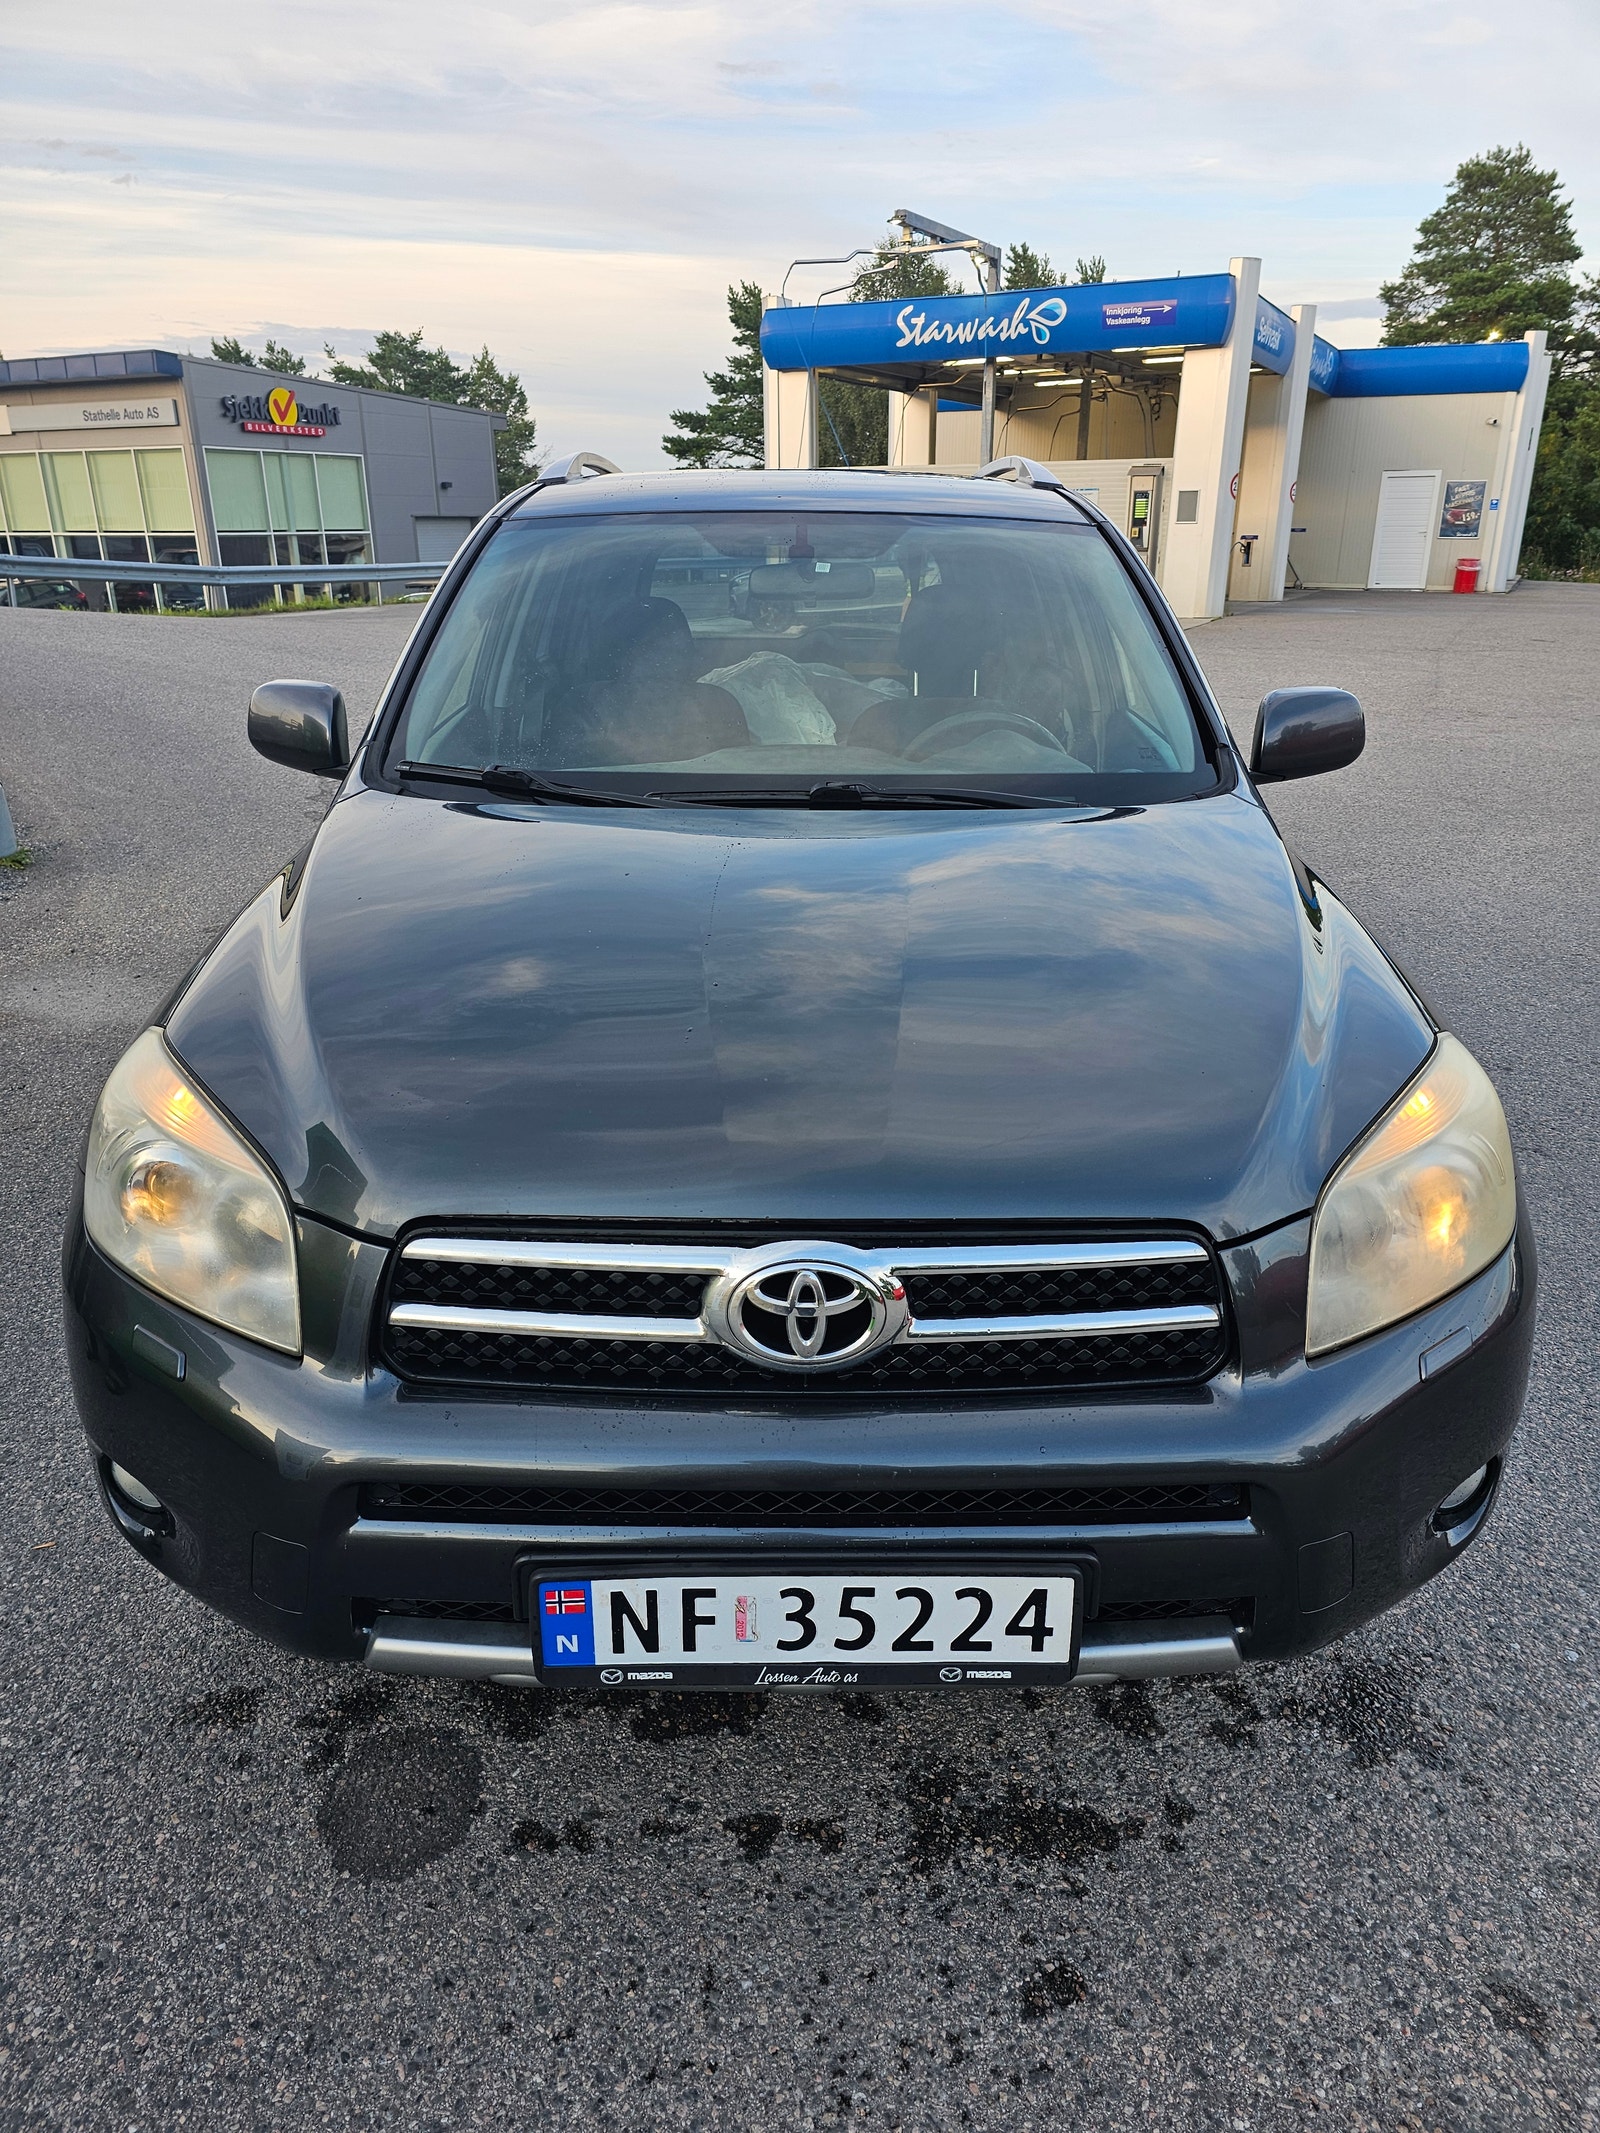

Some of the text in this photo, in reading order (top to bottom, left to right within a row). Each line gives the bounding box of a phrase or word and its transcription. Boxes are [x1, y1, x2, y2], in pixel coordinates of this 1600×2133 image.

[1106, 306, 1143, 317] Innkjøring
[1106, 316, 1151, 326] Vaskeanlegg
[896, 298, 1030, 347] Starwash
[82, 406, 160, 422] Stathelle Auto AS
[221, 395, 342, 425] Sjekk Punkt
[247, 423, 325, 435] BILVERKSTED
[610, 1586, 1054, 1654] NF 35224
[556, 1634, 579, 1654] N
[754, 1666, 859, 1685] Lassen Auto as
